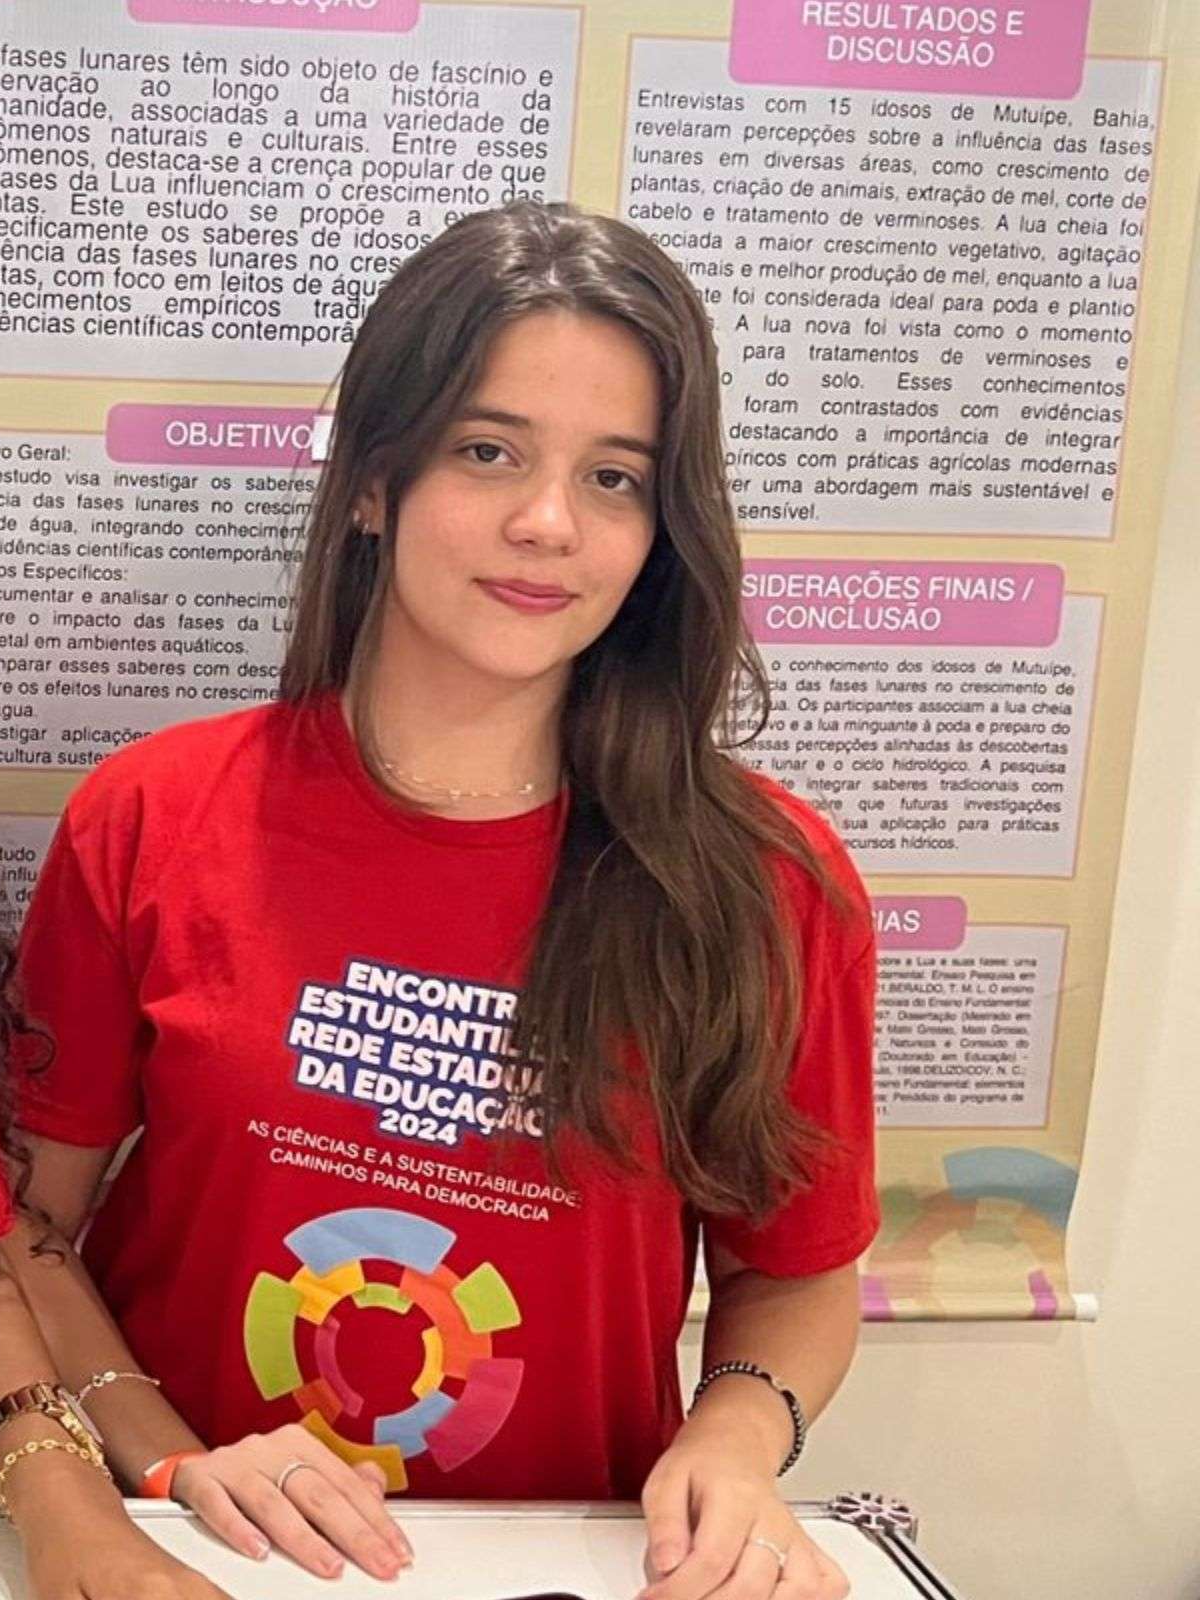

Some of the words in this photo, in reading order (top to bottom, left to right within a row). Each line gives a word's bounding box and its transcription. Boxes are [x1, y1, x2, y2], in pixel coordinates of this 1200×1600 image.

[802, 1, 997, 34] RESULTADOS
[1006, 10, 1025, 36] E
[1, 45, 66, 68] fases
[80, 48, 170, 72] lunares
[183, 52, 227, 74] têm
[240, 54, 290, 76] sido
[302, 57, 376, 83] objeto
[389, 59, 419, 81] de
[432, 61, 526, 85] fascínio
[539, 71, 553, 86] e
[827, 35, 995, 67] DISCUSSÃO
[141, 82, 171, 98] ao
[213, 79, 279, 106] longo
[320, 82, 349, 104] da
[392, 85, 479, 108] história
[522, 89, 550, 110] da
[638, 88, 744, 111] Entrevistas
[765, 99, 806, 114] com
[831, 96, 851, 116] 15
[872, 98, 931, 119] idosos
[951, 101, 974, 121] de
[131, 102, 267, 125] associadas
[284, 111, 298, 126] a
[316, 112, 366, 128] uma
[384, 109, 504, 132] variedade
[520, 112, 549, 134] de
[111, 125, 207, 148] naturais
[228, 134, 242, 149] e
[392, 133, 456, 155] Entre
[477, 142, 547, 158] esses
[636, 118, 731, 138] revelaram
[744, 123, 855, 146] percepções
[868, 126, 920, 146] sobre
[932, 133, 943, 146] a
[956, 128, 1041, 150] influência
[1054, 132, 1087, 152] das
[1100, 134, 1152, 154] fases
[106, 147, 239, 172] destaca-se
[248, 157, 261, 172] a
[272, 158, 352, 180] crença
[362, 156, 454, 182] popular
[463, 158, 492, 179] de
[502, 165, 545, 185] que
[634, 144, 703, 165] lunares
[720, 153, 748, 167] em
[764, 149, 844, 170] diversas
[932, 161, 983, 176] como
[997, 159, 1109, 180] crescimento
[1125, 162, 1150, 182] de
[714, 175, 783, 199] criação
[790, 177, 814, 197] de
[907, 182, 985, 206] extração
[992, 185, 1014, 204] de
[1066, 188, 1114, 208] corte
[1122, 189, 1147, 209] de
[84, 314, 203, 338] científicas
[212, 319, 353, 346] contemporâ
[745, 395, 798, 415] foram
[821, 397, 938, 417] contrastados
[960, 405, 998, 419] com
[1021, 401, 1122, 421] evidências
[66, 469, 99, 486] visa
[114, 470, 197, 491] investigar
[211, 477, 231, 489] os
[246, 474, 314, 491] saberes
[33, 492, 64, 509] das
[78, 493, 123, 510] fases
[136, 495, 199, 512] lunares
[212, 502, 233, 513] no
[245, 499, 315, 515] crescim
[77, 540, 163, 558] científicas
[169, 543, 305, 563] contemporânea
[741, 571, 920, 604] SIDERAÇÕES
[928, 577, 1015, 601] FINAIS
[765, 601, 942, 630] CONCLUSÃO
[35, 638, 61, 649] em
[67, 634, 156, 651] ambientes
[771, 661, 781, 672] o
[789, 658, 888, 673] conhecimento
[897, 659, 922, 673] dos
[932, 659, 976, 674] idosos
[985, 660, 1002, 675] de
[796, 677, 821, 692] das
[830, 677, 867, 692] fases
[876, 678, 927, 693] lunares
[935, 683, 953, 693] no
[960, 680, 1047, 695] crescimento
[1056, 680, 1074, 695] de
[880, 816, 946, 833] aplicação
[958, 820, 989, 834] para
[1002, 817, 1059, 834] práticas
[345, 961, 518, 1019] ENCONTR
[289, 1018, 385, 1064] REDE
[297, 1055, 348, 1093] DA
[941, 1054, 957, 1062] em
[248, 1120, 270, 1138] AS
[274, 1125, 358, 1158] CIÊNCIAS
[364, 1149, 377, 1162] E
[380, 1151, 393, 1166] A
[379, 1109, 458, 1146] 2024
[270, 1149, 367, 1183] CAMINHOS
[372, 1173, 421, 1196] PARA
[426, 1184, 550, 1221] DEMOCRACIA
